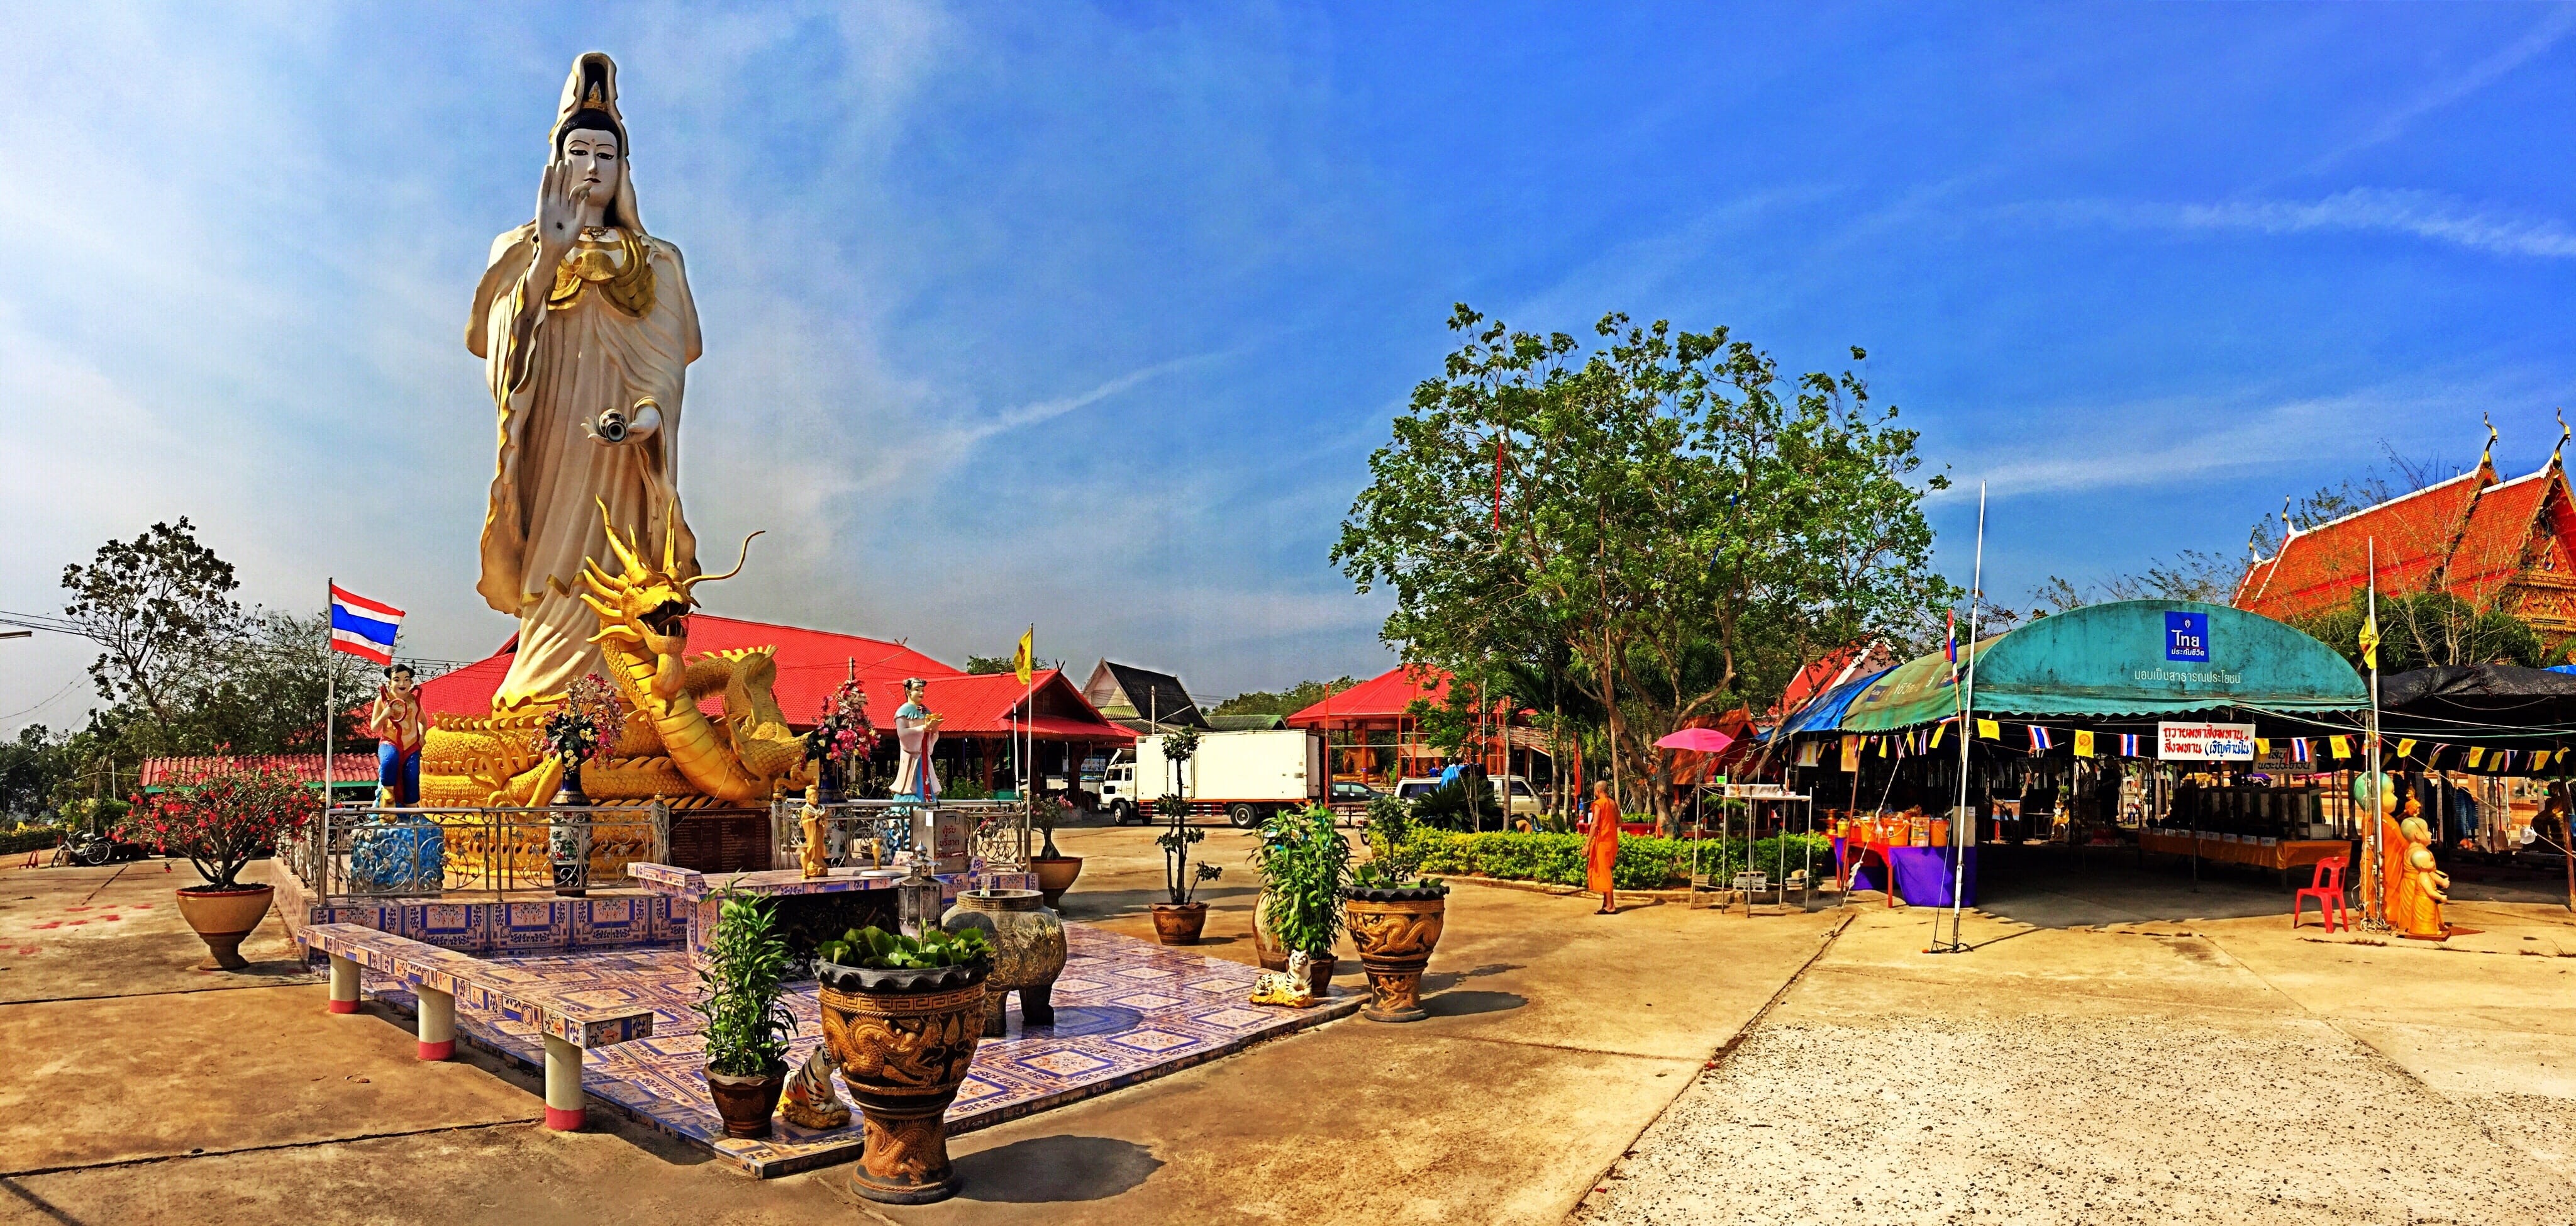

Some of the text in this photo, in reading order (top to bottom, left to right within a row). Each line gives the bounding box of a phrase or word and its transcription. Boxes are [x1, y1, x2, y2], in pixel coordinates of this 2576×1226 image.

[2171, 629, 2199, 647] ไทย
[2172, 648, 2204, 656] ประกันชีวิต
[2135, 667, 2241, 684] มอบเป็นสาธารณประโยชน์
[2165, 739, 2202, 754] สังฆทาน
